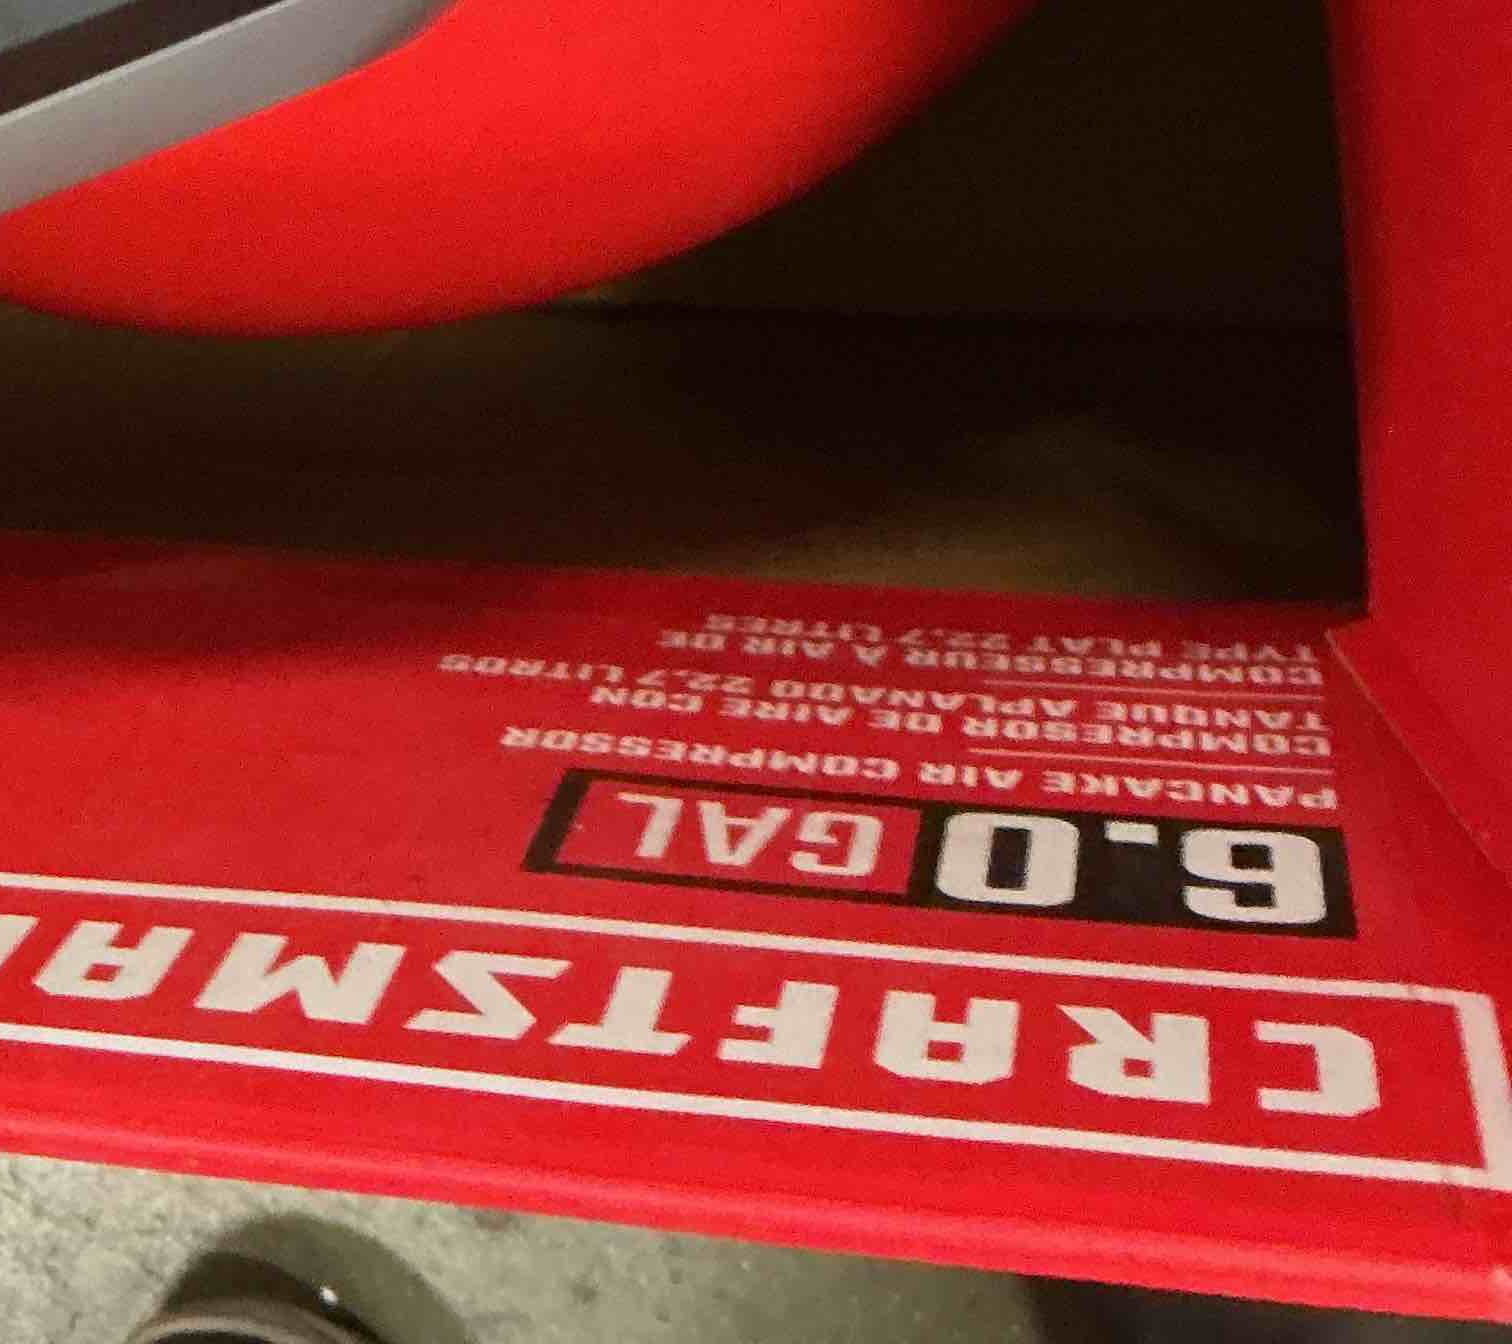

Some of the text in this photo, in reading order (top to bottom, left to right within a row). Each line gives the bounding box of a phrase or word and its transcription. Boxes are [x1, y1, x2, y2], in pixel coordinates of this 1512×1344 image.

[733, 631, 836, 662] AIR
[901, 645, 1325, 688] COMPRESSEUR
[437, 653, 1328, 732] TANQUE APLANADO 22.7 LITROS
[589, 687, 1331, 757] COMPRESOR DE AIRE CON
[498, 725, 1338, 810] PANCAKE AIR COMPRESSOR
[611, 791, 1328, 925] 6.0 GAL
